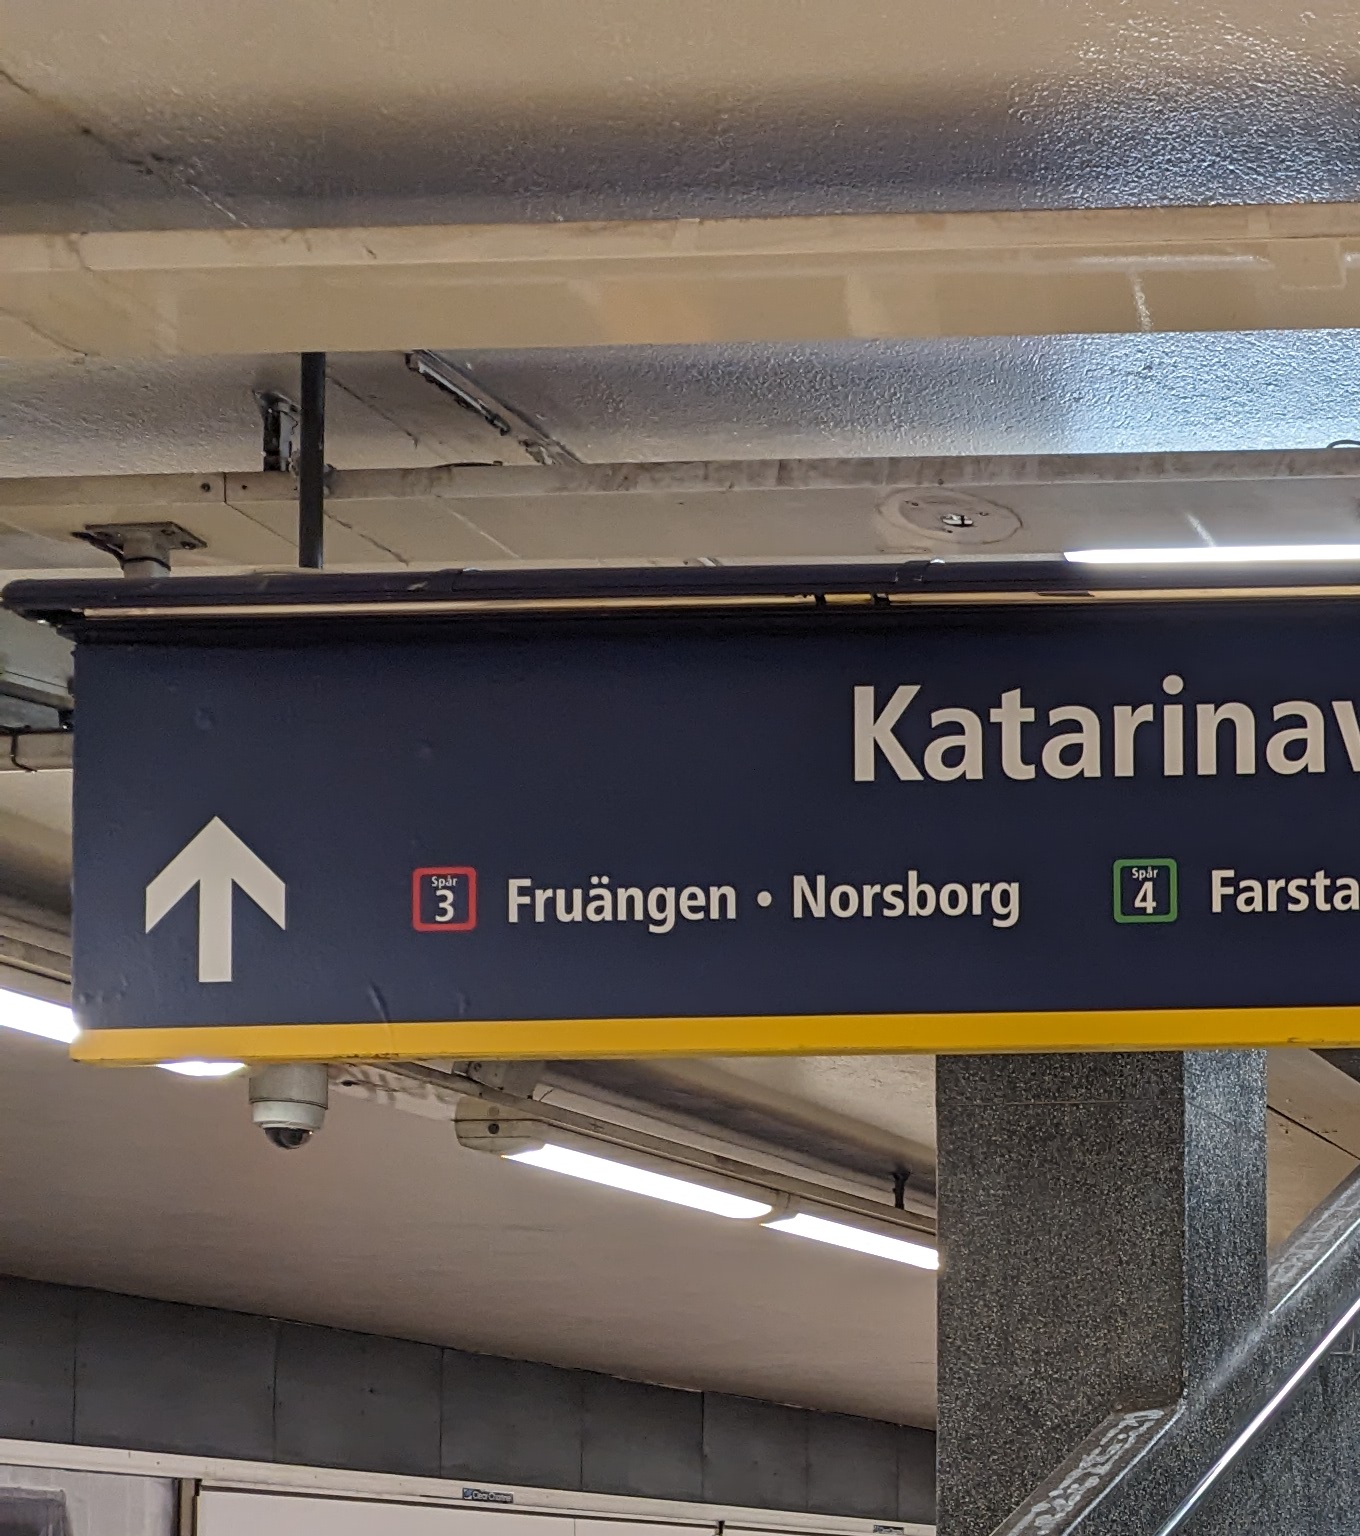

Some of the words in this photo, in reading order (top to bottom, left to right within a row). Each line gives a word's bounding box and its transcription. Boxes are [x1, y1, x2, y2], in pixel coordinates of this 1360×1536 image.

[431, 875, 458, 888] Spår
[1132, 866, 1159, 881] Spår
[435, 889, 454, 922] 3
[508, 876, 737, 933] Fruängen
[793, 870, 1020, 928] Norsborg
[1134, 881, 1157, 914] 4
[1211, 869, 1360, 913] Farsta
